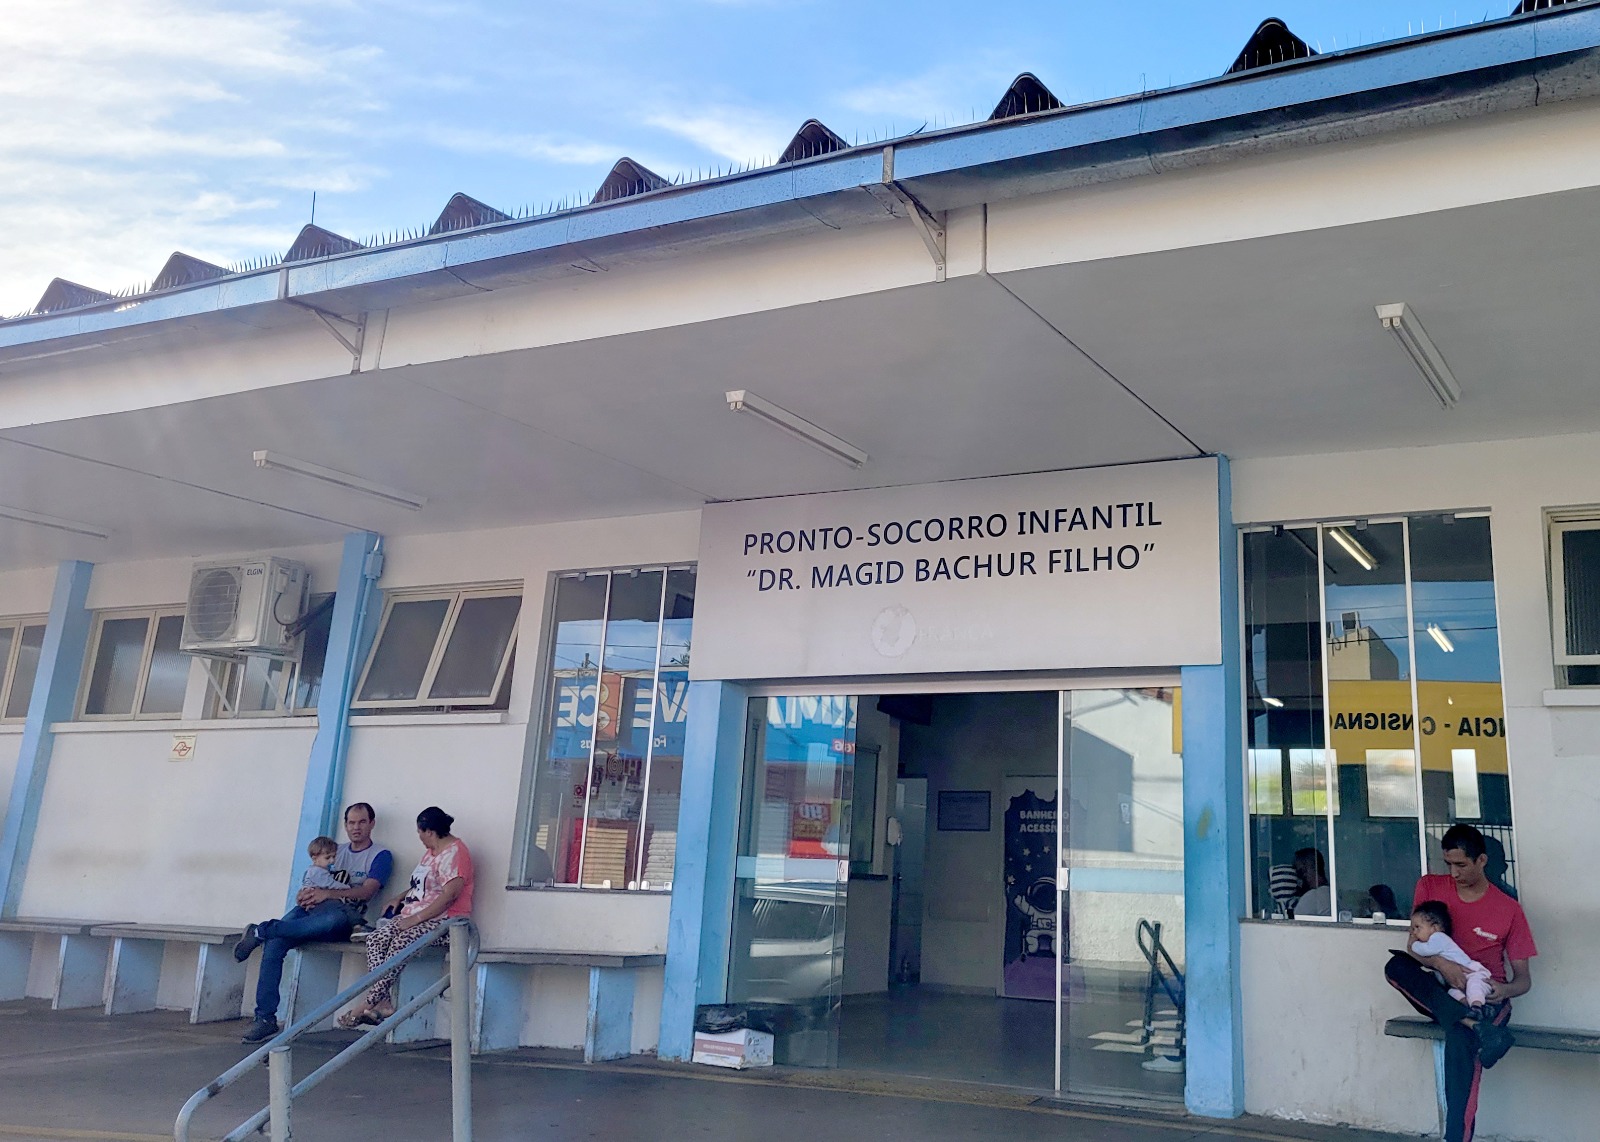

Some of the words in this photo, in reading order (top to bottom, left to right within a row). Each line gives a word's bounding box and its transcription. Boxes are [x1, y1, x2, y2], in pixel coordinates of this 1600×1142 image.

[743, 512, 1008, 556] PRONTO-SOCORRO
[1017, 501, 1163, 536] INFANTIL
[246, 568, 263, 576] ELGIN
[811, 560, 905, 589] MAGID
[915, 551, 1037, 583] BACHUR
[1019, 810, 1070, 820] BANHEIO
